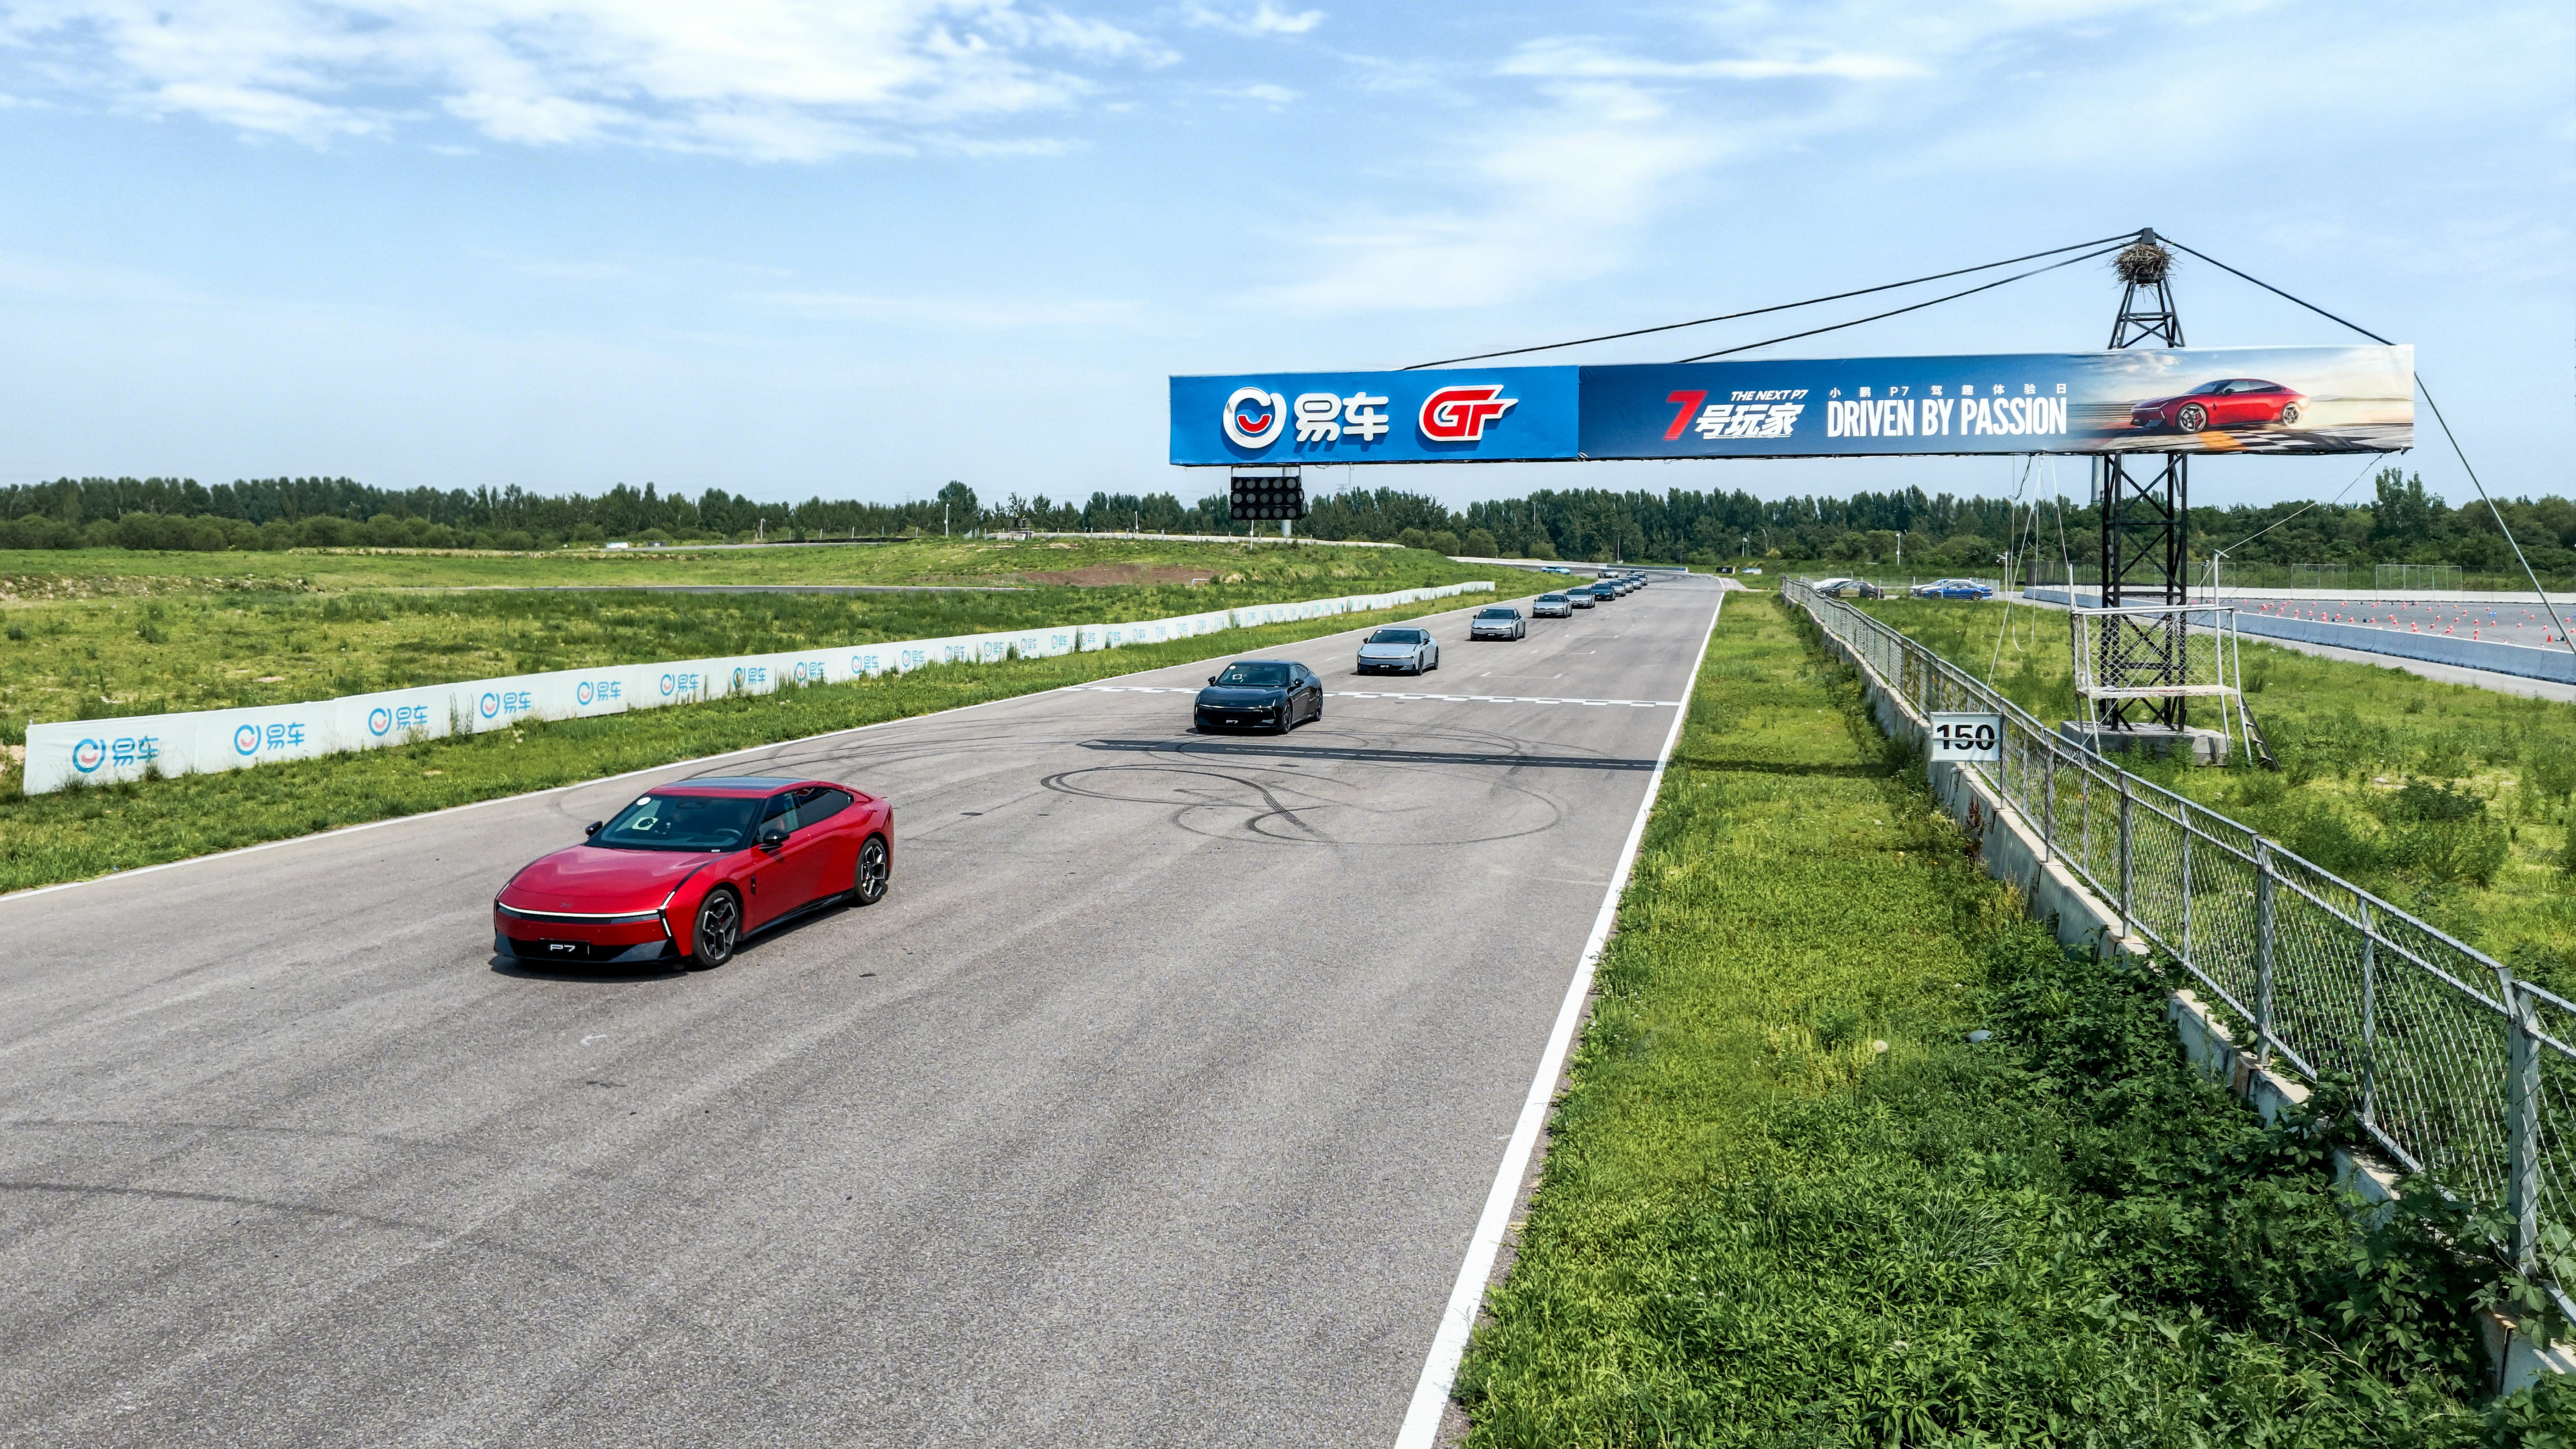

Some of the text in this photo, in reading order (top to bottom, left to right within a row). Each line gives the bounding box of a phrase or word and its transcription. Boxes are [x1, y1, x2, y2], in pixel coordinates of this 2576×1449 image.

[1731, 389, 1809, 401] THE NEXT P7
[1294, 392, 1389, 441] 易车
[1419, 384, 1519, 441] GT
[1827, 397, 2067, 437] DRIVEN BY PASSION
[678, 673, 699, 693] 易车
[748, 667, 766, 685] 易车
[503, 691, 531, 714] 易车
[597, 681, 621, 701] 易车
[396, 705, 428, 731] 易车
[266, 722, 305, 750] 易车
[1937, 724, 1995, 750] 150
[112, 735, 159, 767] 易车
[550, 944, 576, 952] P7
